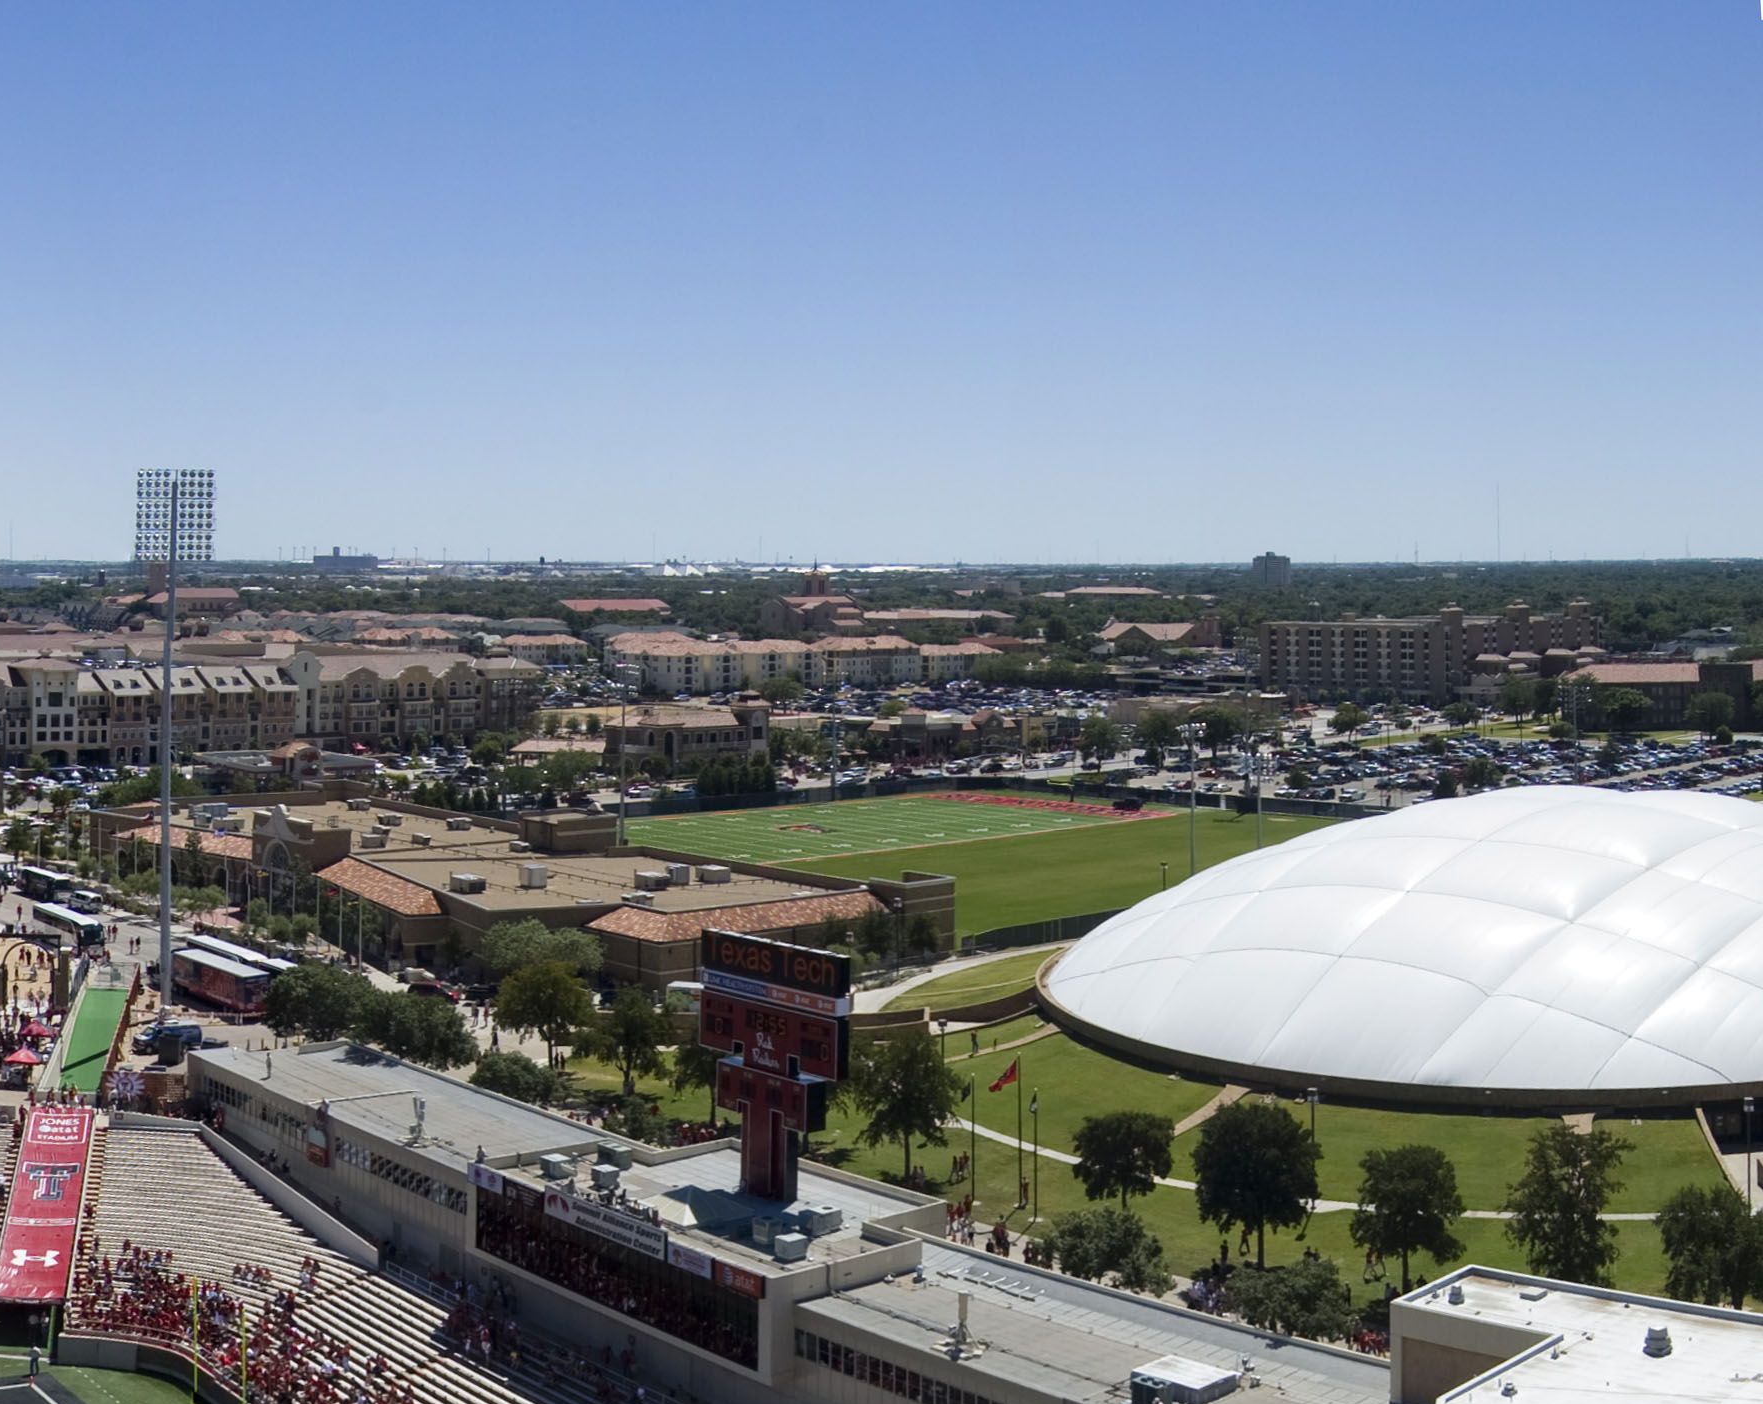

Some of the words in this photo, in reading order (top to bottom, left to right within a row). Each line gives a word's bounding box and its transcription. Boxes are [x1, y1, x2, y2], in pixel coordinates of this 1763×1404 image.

[708, 933, 772, 974] Texas
[780, 948, 835, 987] Tech
[635, 1224, 663, 1244] Sports
[633, 1236, 662, 1257] Center
